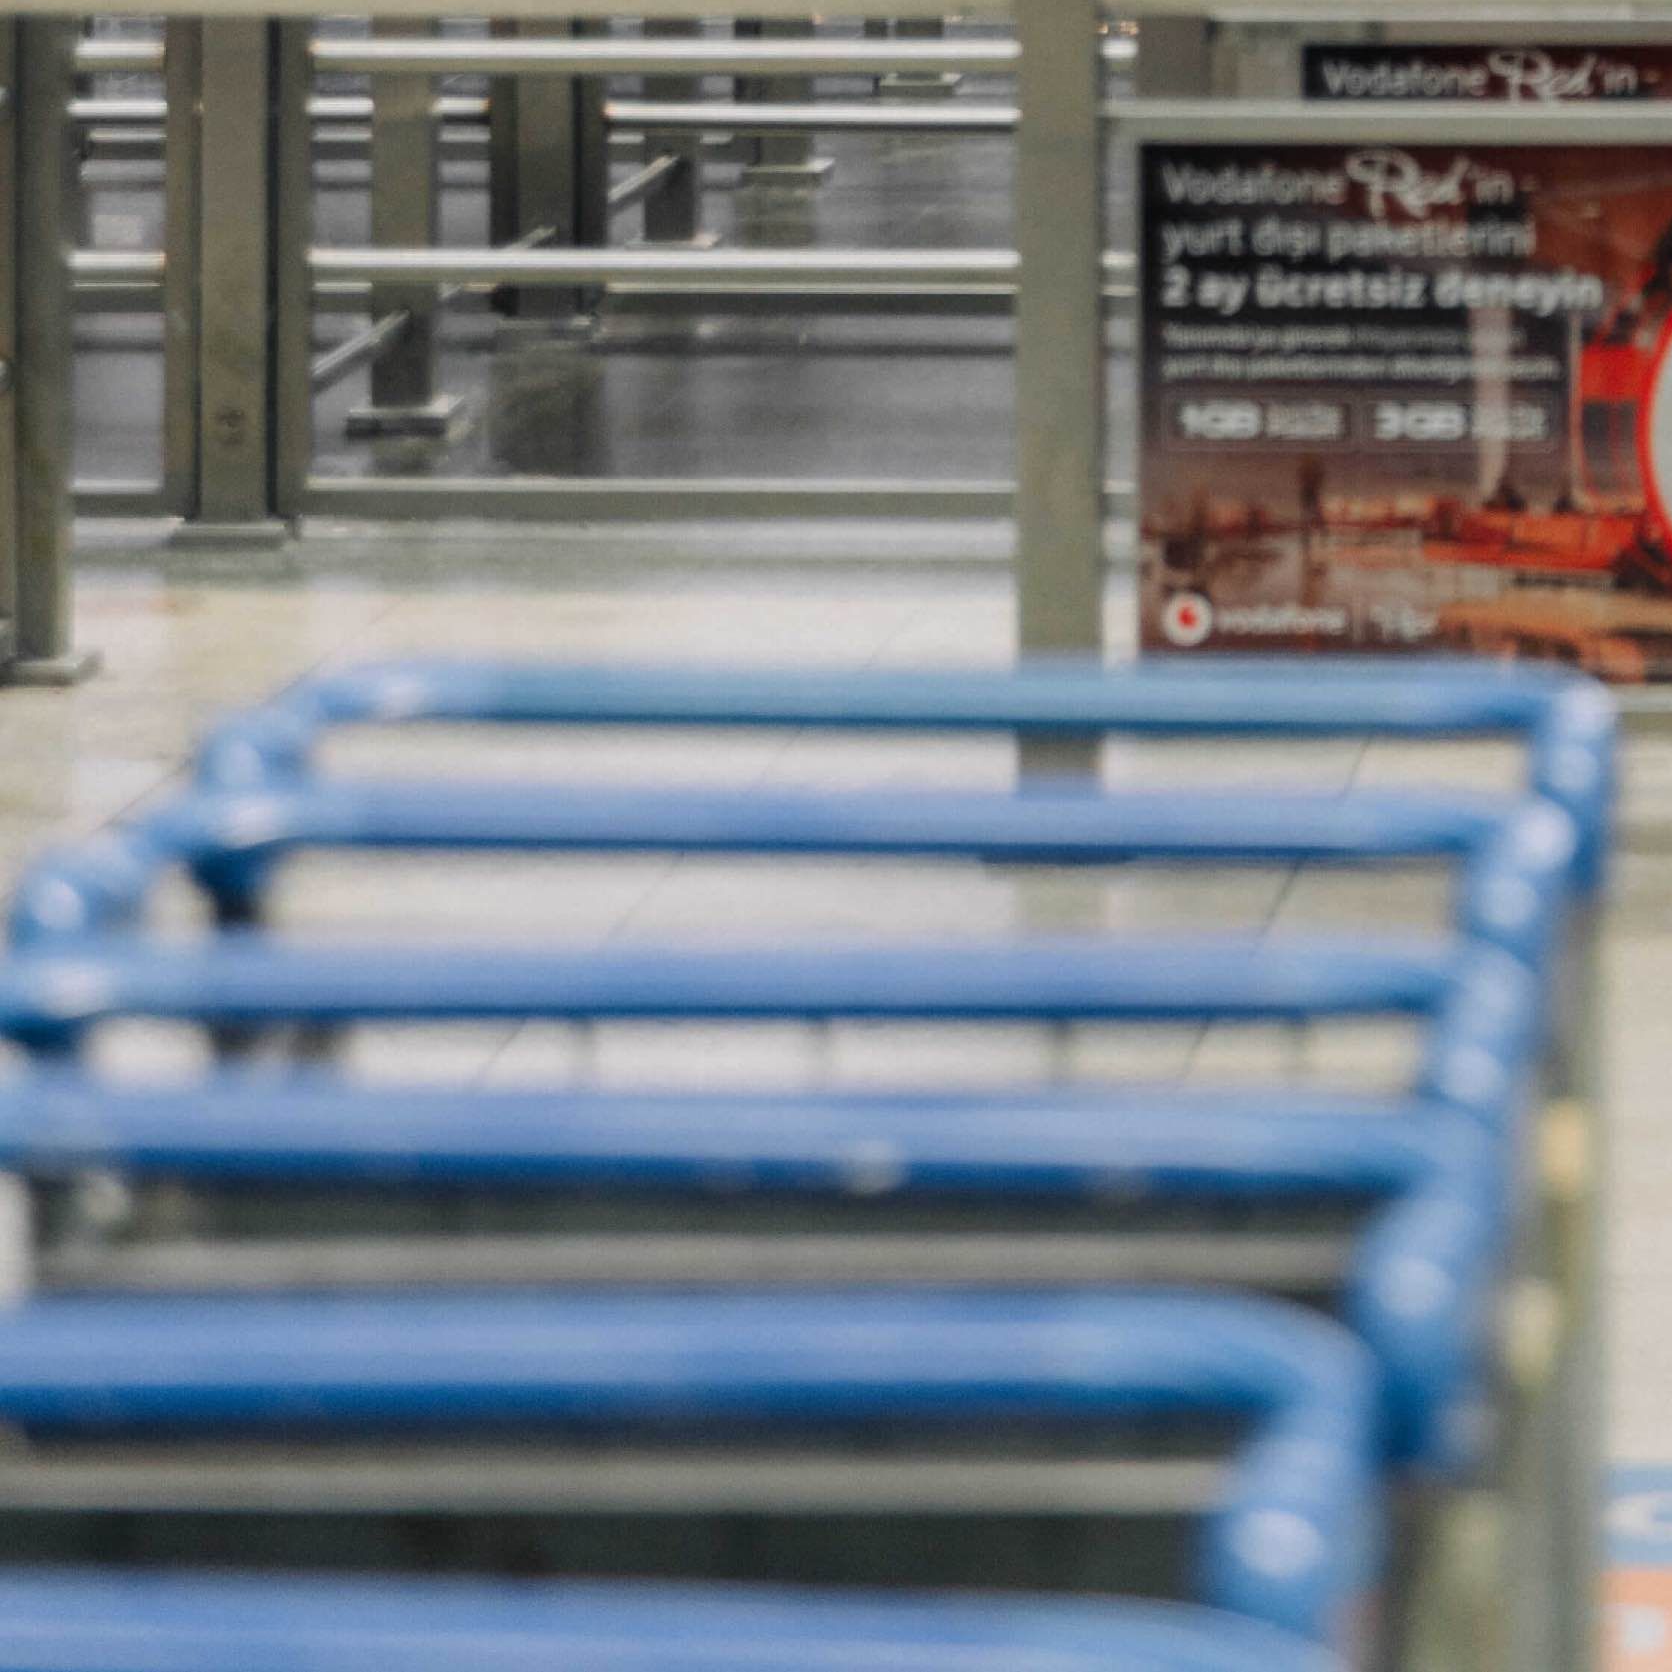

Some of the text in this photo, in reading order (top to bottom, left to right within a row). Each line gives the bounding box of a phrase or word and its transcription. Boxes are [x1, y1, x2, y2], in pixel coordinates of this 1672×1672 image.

[1322, 58, 1489, 98] Vodafone
[1162, 160, 1347, 206] Vodafone
[1160, 267, 1193, 308] 2
